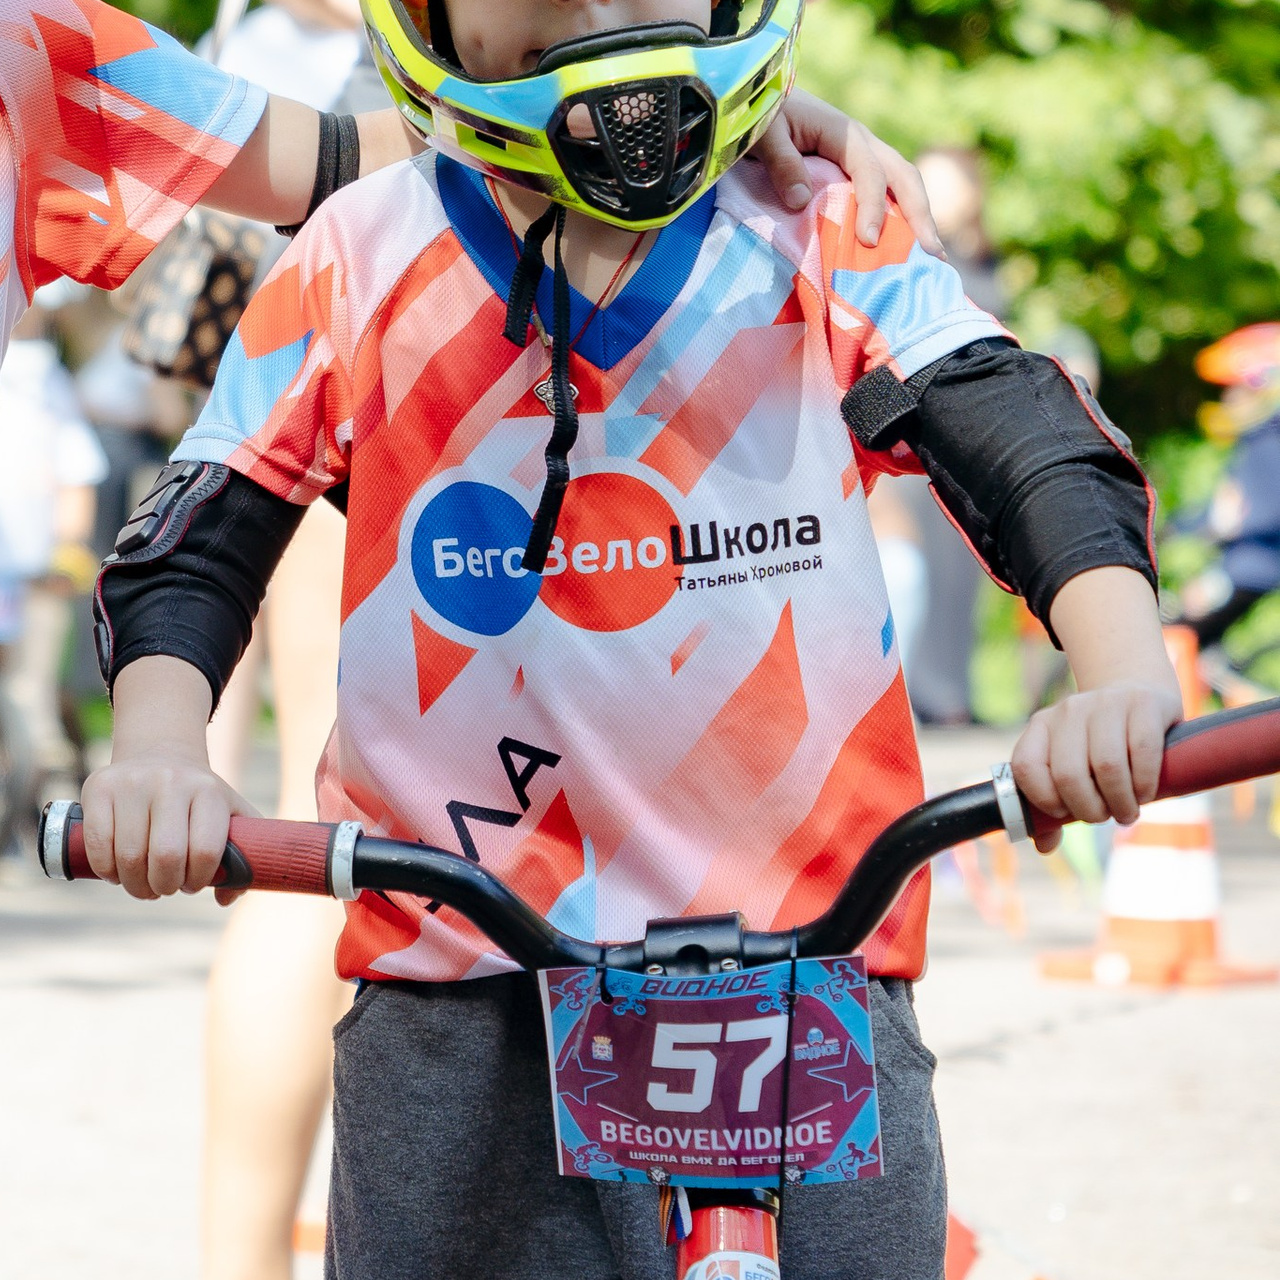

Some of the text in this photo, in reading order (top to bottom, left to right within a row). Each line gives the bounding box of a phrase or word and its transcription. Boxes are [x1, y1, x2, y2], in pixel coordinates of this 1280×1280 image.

[675, 555, 824, 592] Татьяны Хромовой
[444, 735, 562, 863] ЛА
[646, 1014, 789, 1113] 57
[600, 1120, 833, 1151] BEGOVELVIDNOE
[629, 1151, 678, 1163] ШКОЛА
